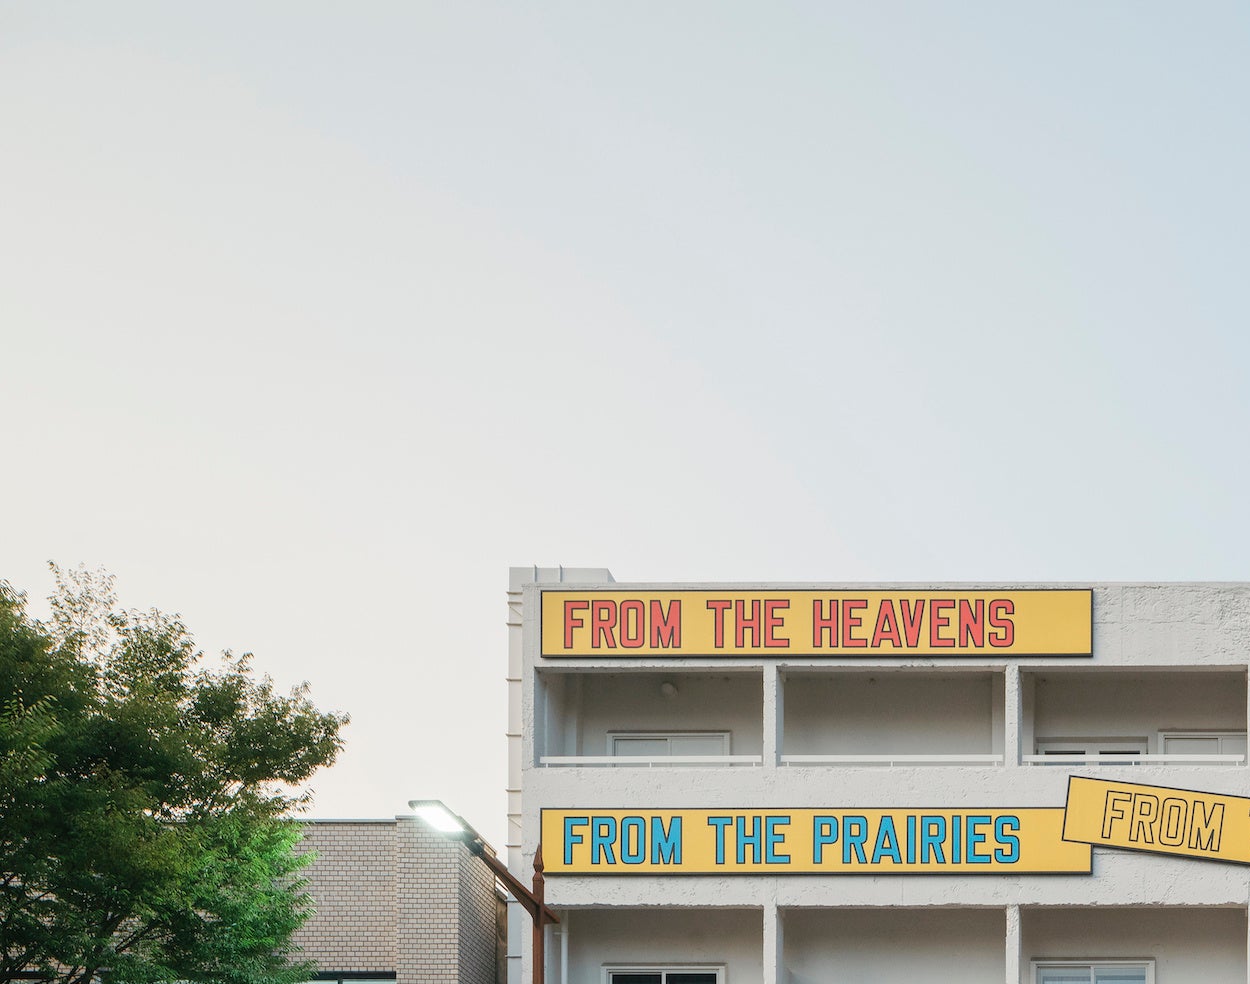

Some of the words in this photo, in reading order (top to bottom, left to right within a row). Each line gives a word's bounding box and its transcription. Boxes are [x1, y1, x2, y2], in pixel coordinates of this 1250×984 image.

[563, 599, 682, 650] FROM
[706, 599, 791, 649] THE
[812, 599, 1016, 649] HEAVENS
[563, 815, 683, 866] FROM
[707, 815, 791, 865] THE
[812, 815, 1021, 865] PRAIRIES
[1101, 790, 1226, 852] FROM
